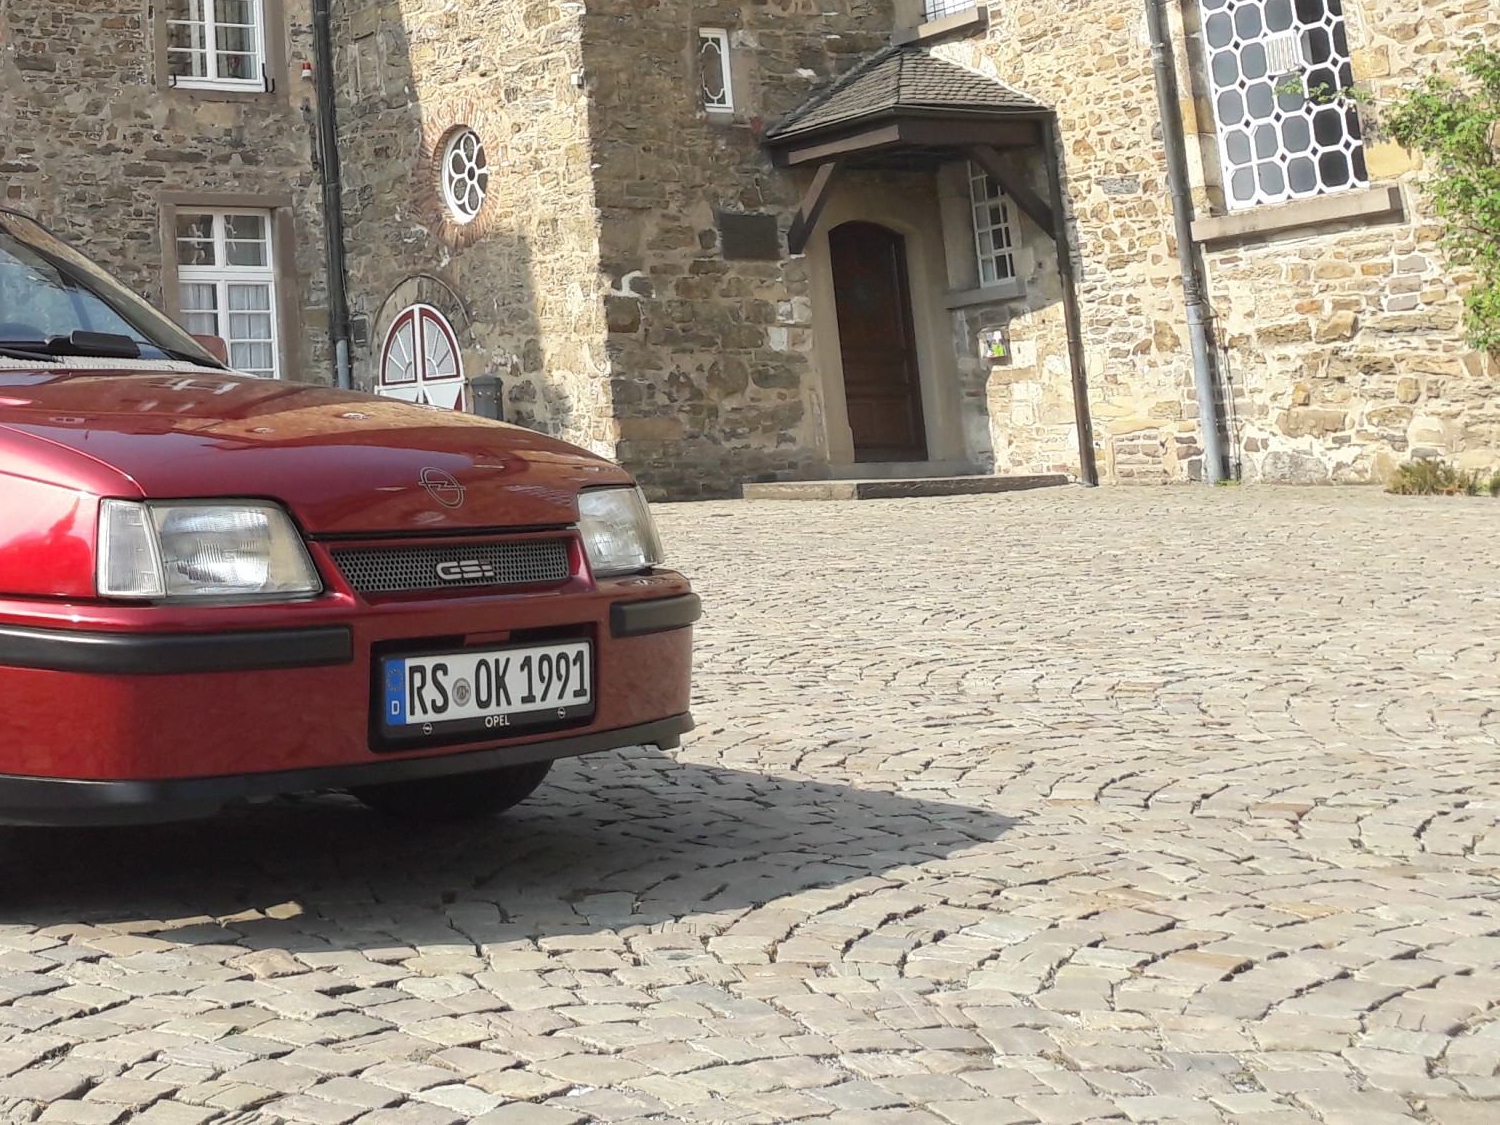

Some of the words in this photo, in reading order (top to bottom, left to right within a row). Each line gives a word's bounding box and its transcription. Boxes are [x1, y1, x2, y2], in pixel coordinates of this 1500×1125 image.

[408, 663, 449, 716] RS
[474, 656, 512, 709] OK
[519, 649, 587, 704] 1991
[391, 700, 400, 715] D
[484, 714, 510, 728] OPEL
